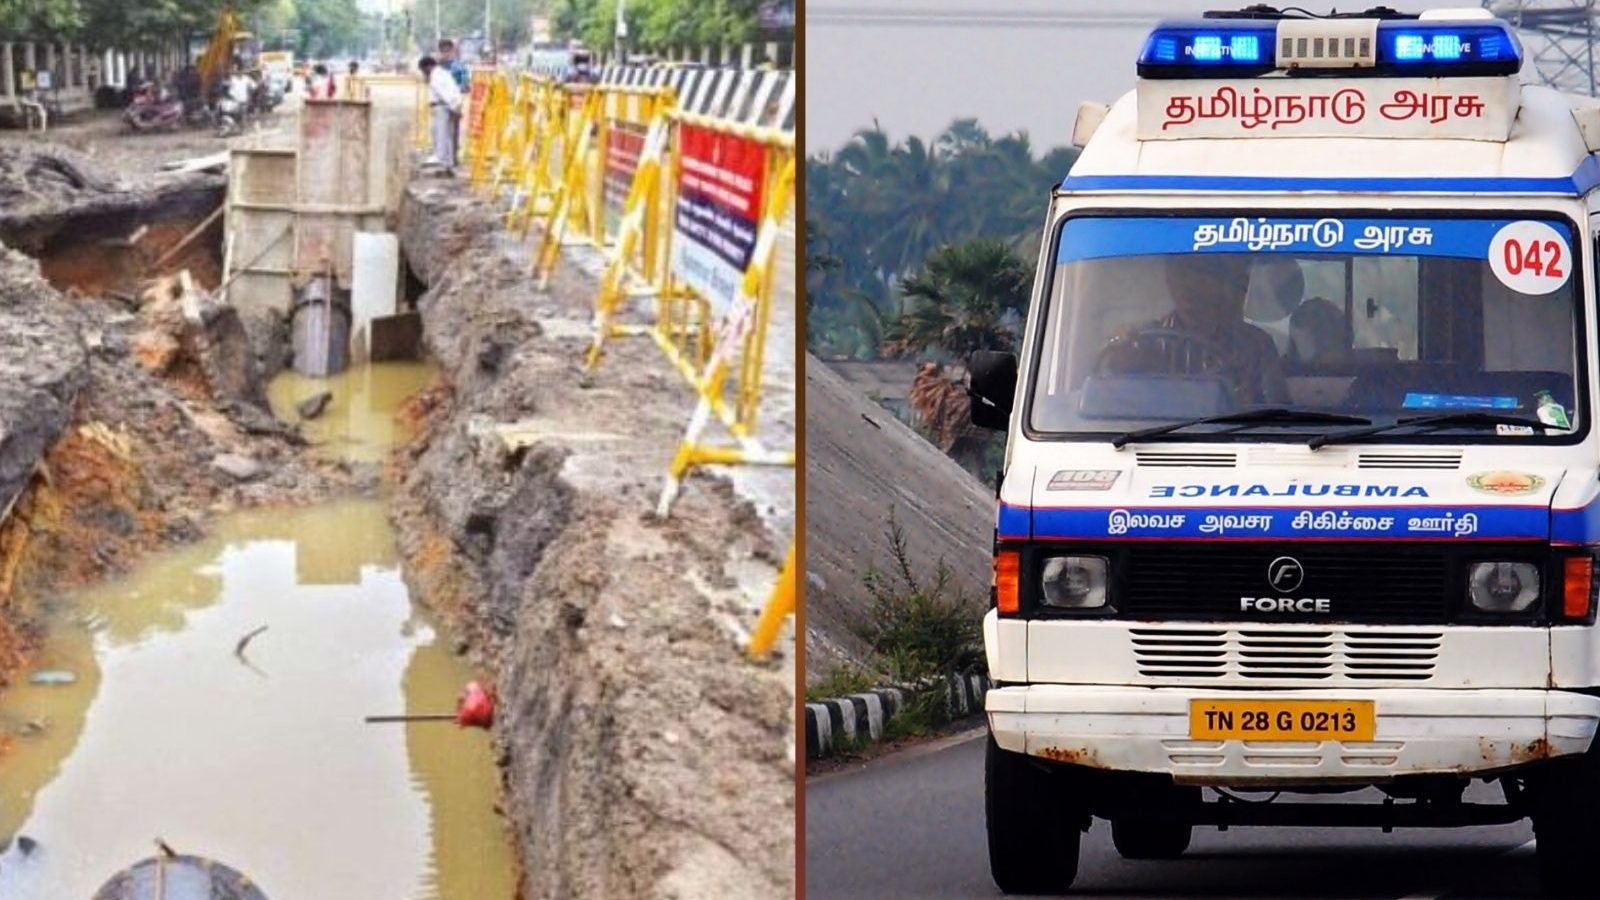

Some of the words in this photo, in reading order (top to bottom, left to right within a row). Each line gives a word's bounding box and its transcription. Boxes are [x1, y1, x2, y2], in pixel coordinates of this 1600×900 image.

[1163, 86, 1366, 130] தமிழ்நாடு
[1379, 90, 1485, 124] அரசு
[1193, 217, 1344, 251] தமிழ்நாடு
[1353, 225, 1433, 252] அரசு
[1503, 238, 1564, 278] 042
[1108, 509, 1186, 535] இலவச
[1198, 514, 1273, 534] அவசர
[1291, 510, 1395, 532] சிகிச்சை
[1407, 512, 1478, 537] ஊர்தி
[1240, 597, 1331, 613] FORCE
[1205, 710, 1234, 731] TN
[1241, 710, 1270, 731] 28
[1276, 710, 1293, 731] G
[1300, 711, 1356, 732] 0213
